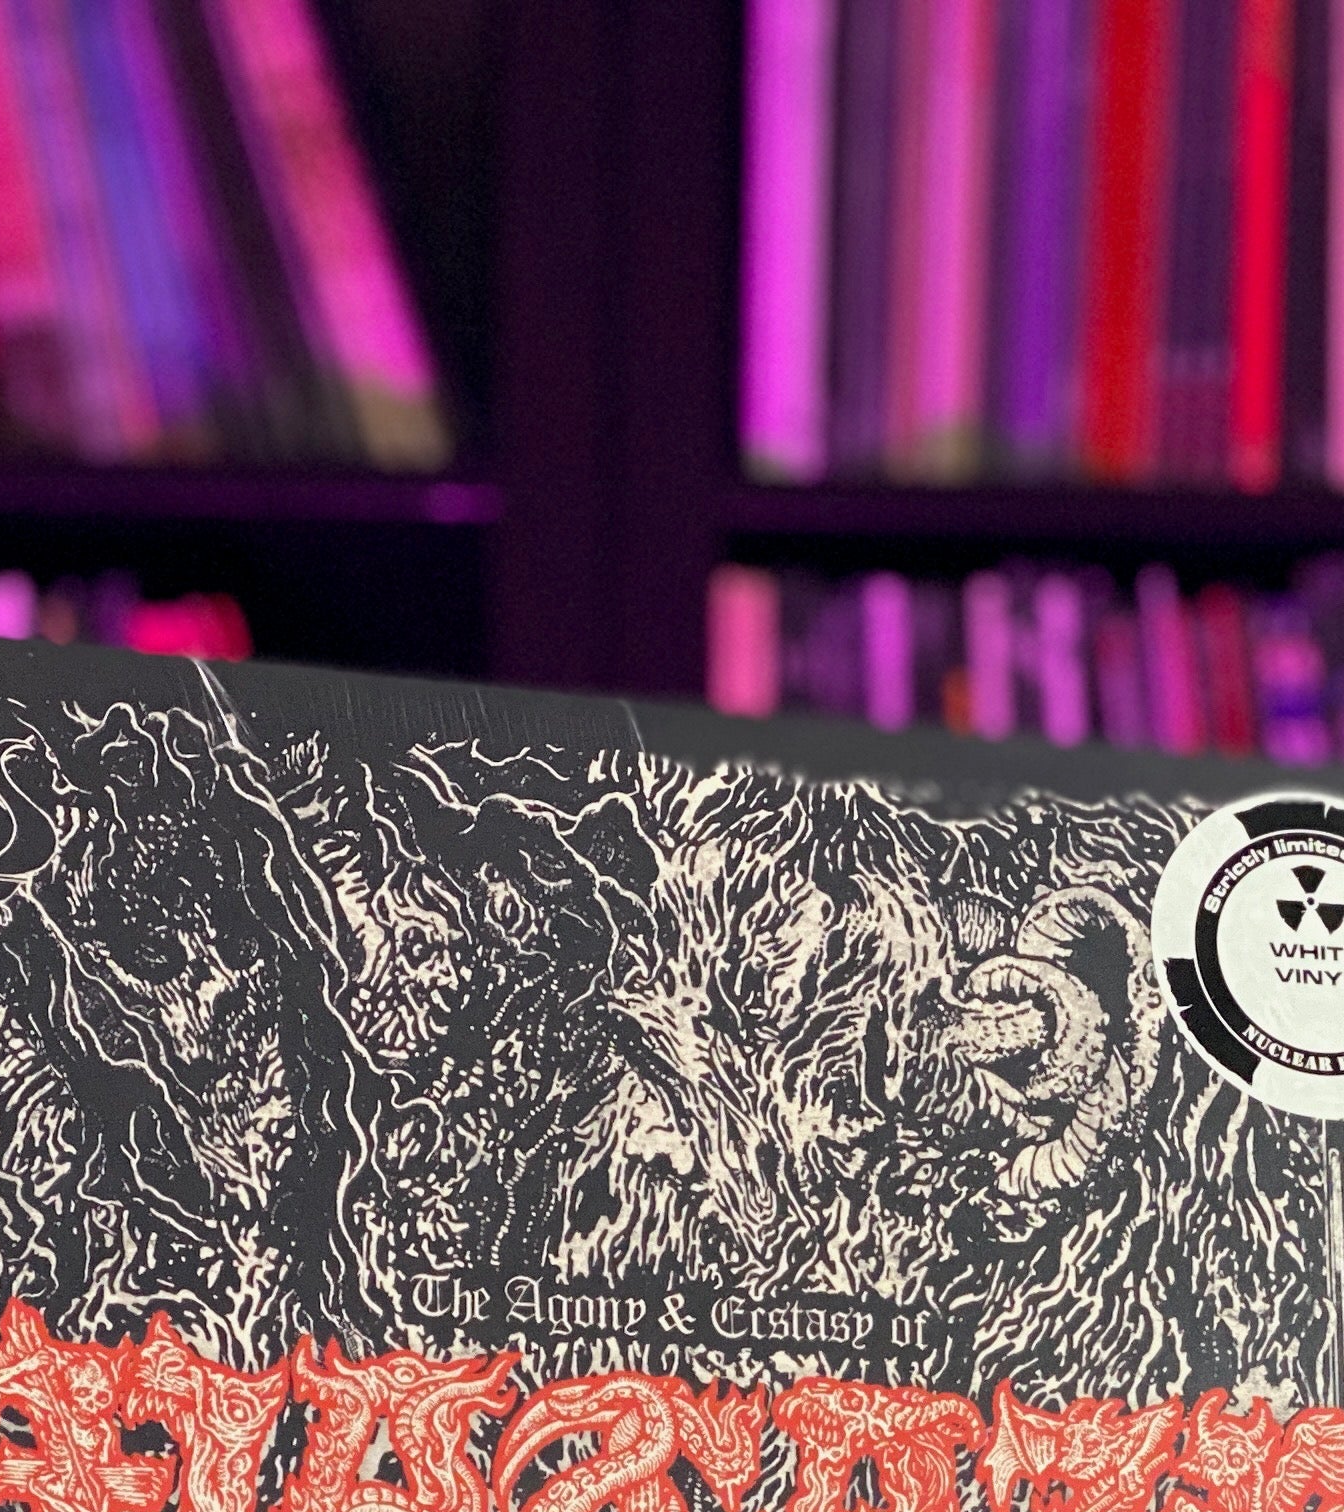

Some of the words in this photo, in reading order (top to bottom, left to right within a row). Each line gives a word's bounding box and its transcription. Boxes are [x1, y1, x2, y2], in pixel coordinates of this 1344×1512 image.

[1204, 843, 1272, 914] Strictly
[1241, 1023, 1335, 1073] NUCLEAR
[409, 1272, 491, 1323] The
[504, 1275, 647, 1336] Agony
[659, 1293, 697, 1336] &
[711, 1293, 874, 1350] Ecstasy
[889, 1308, 932, 1350] of
